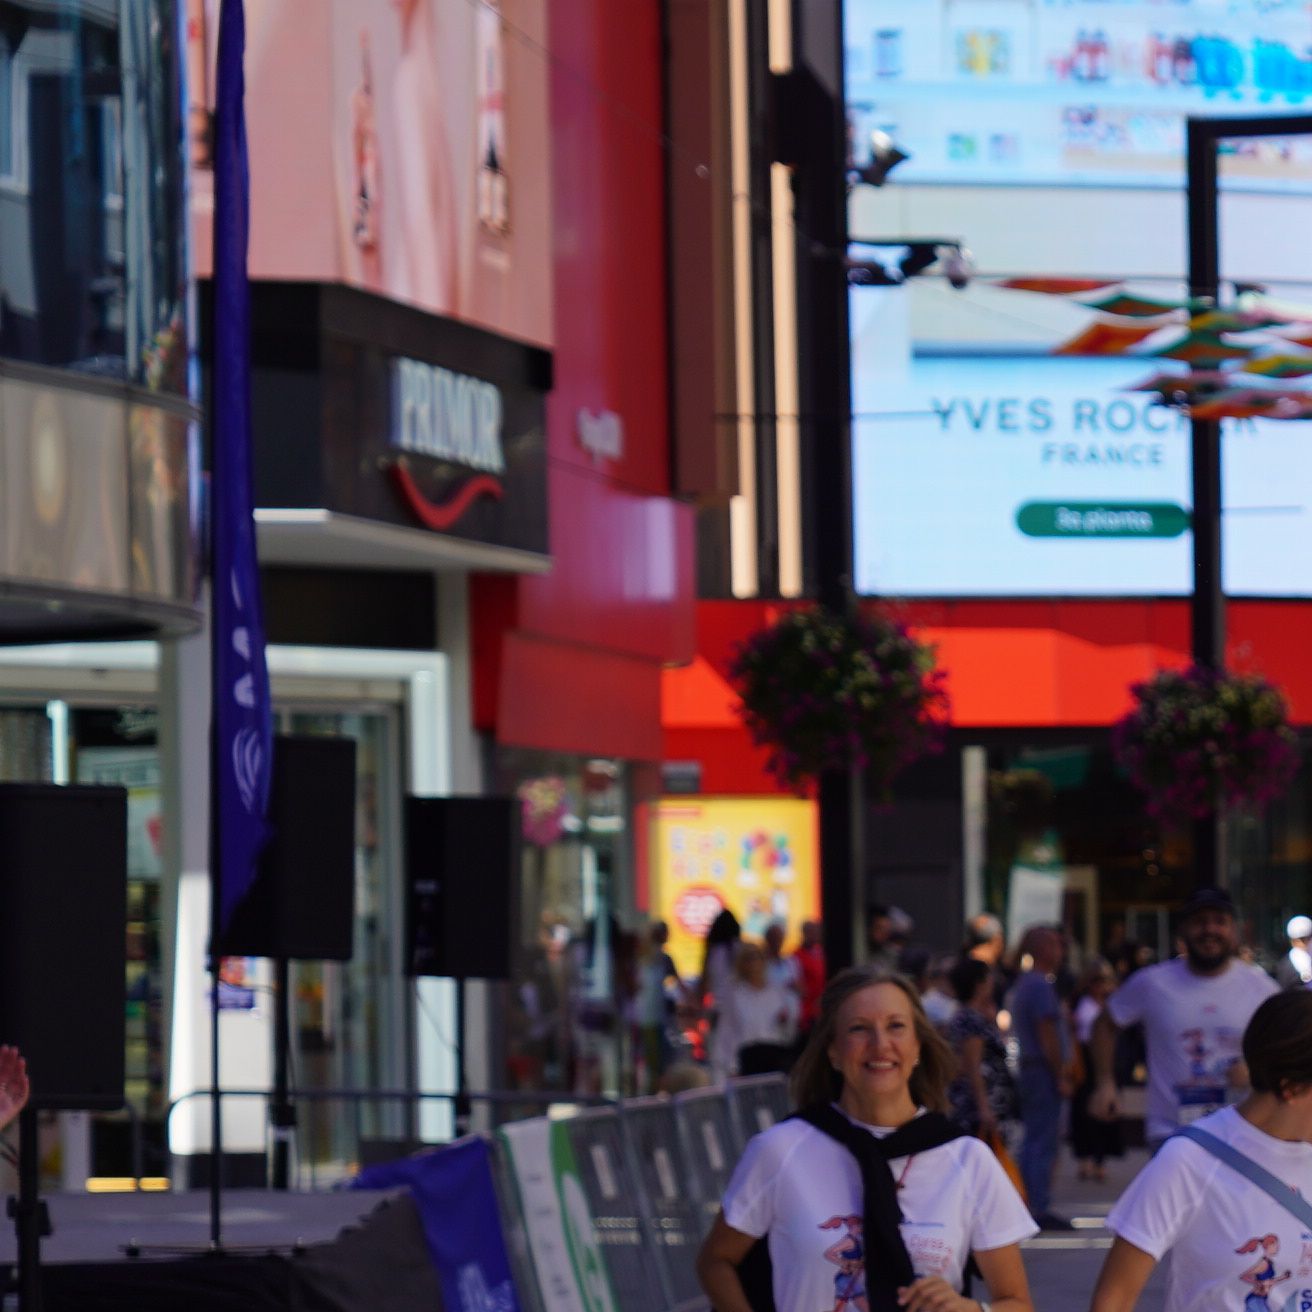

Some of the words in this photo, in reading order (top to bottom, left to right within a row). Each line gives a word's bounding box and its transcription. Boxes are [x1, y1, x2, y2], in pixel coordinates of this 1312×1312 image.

[392, 356, 506, 475] PRIMOR
[932, 397, 1056, 433] YVES
[1041, 443, 1164, 466] FRANCE
